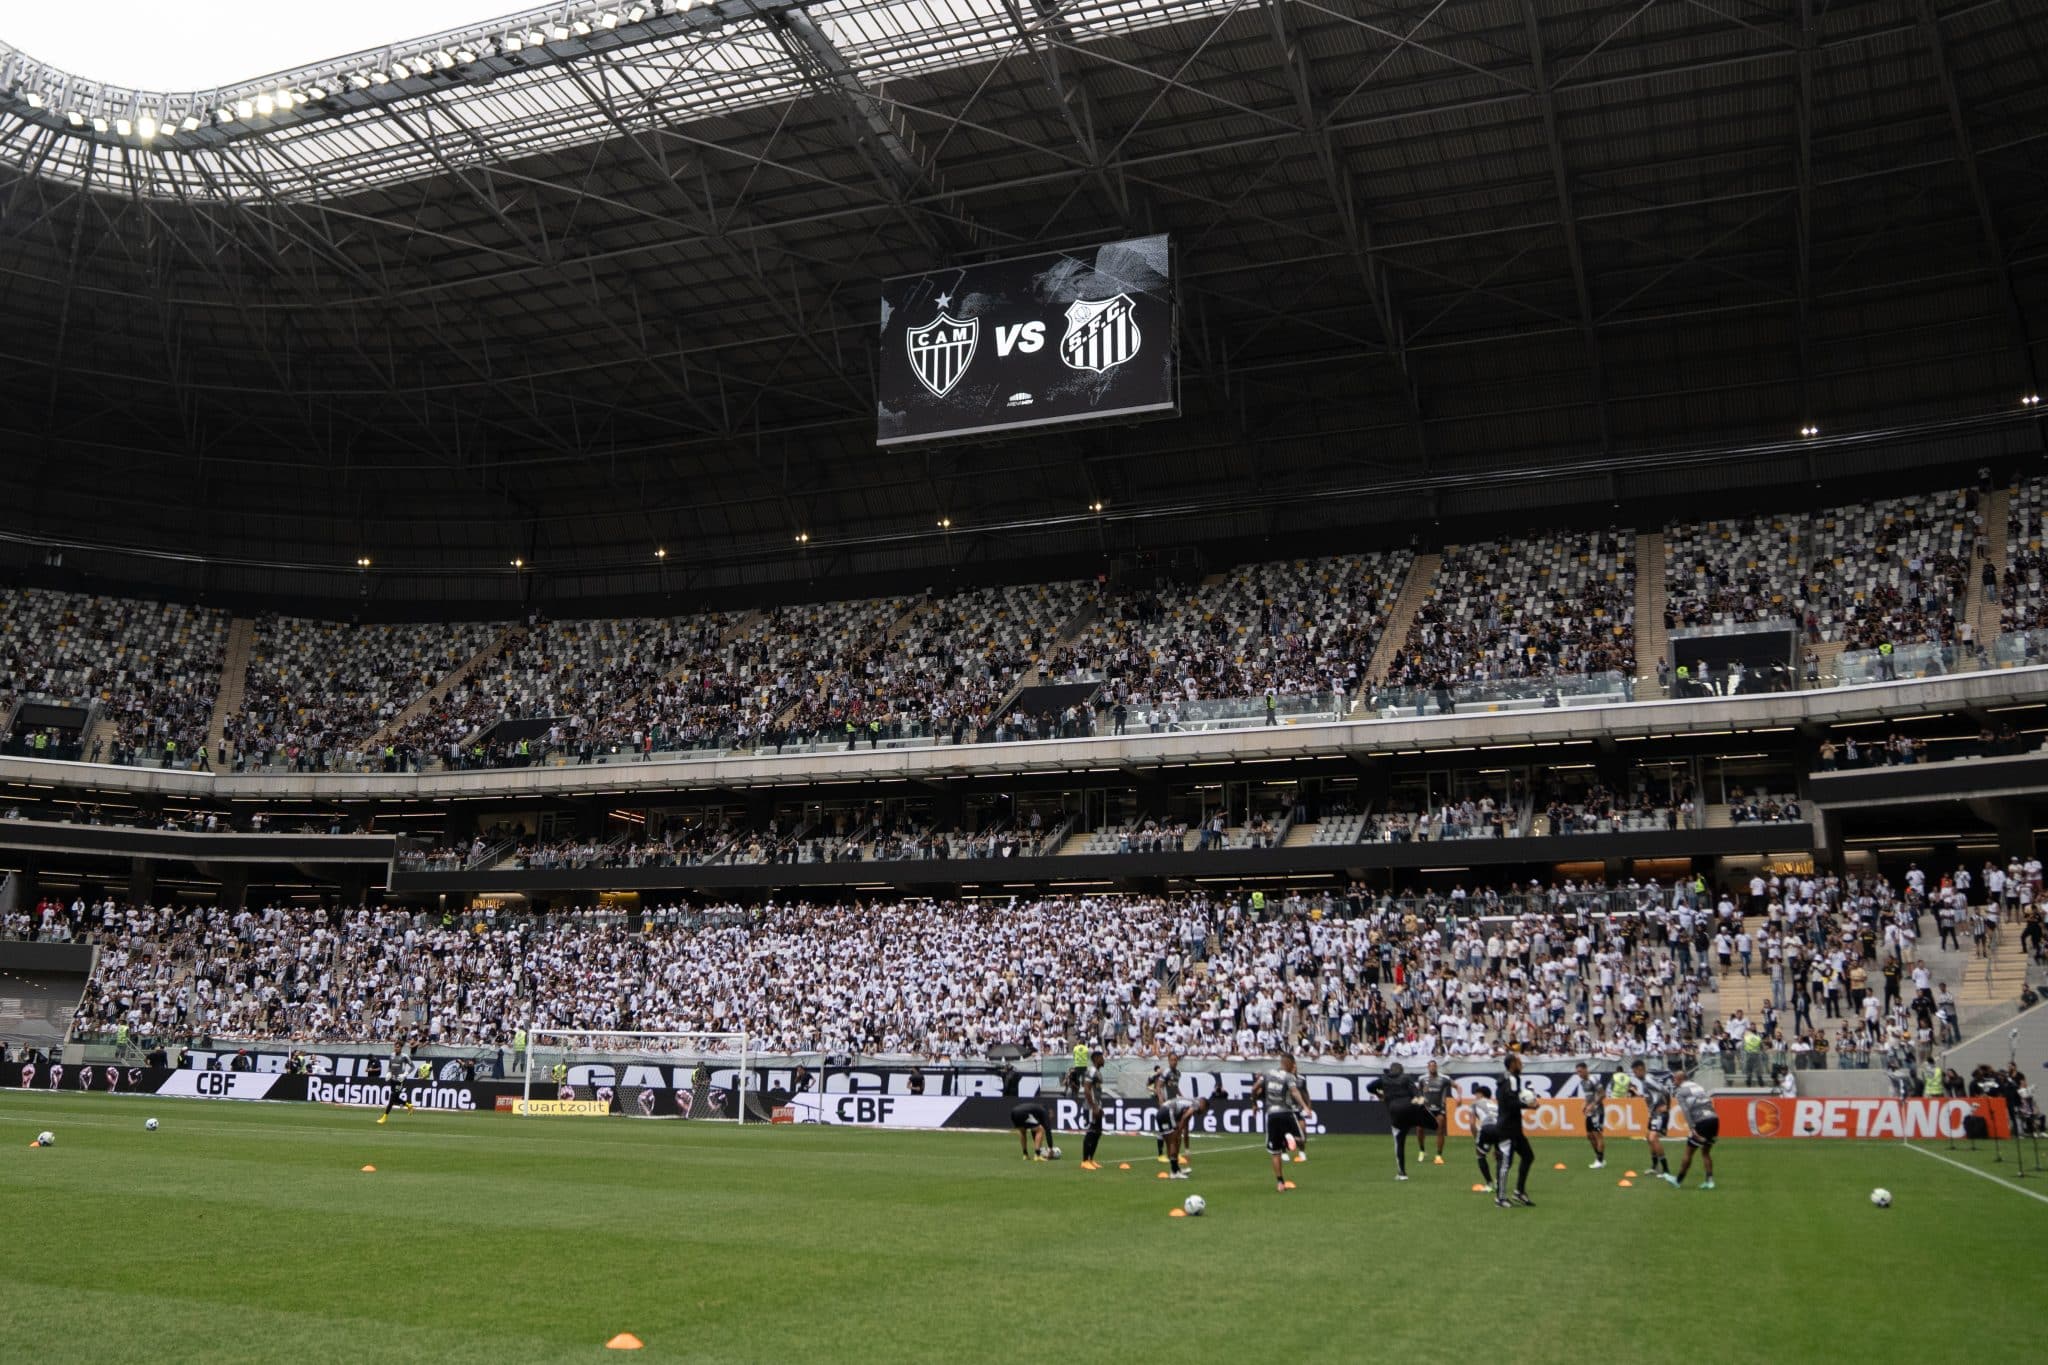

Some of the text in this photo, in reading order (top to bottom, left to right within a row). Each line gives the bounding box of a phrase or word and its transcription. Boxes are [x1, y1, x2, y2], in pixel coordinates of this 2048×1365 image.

[917, 327, 967, 347] CAM
[995, 320, 1047, 357] VS
[196, 1072, 237, 1095] CBF
[307, 1076, 392, 1106] Racismo
[411, 1081, 476, 1110] crime.
[837, 1097, 895, 1123] CBF
[1057, 1099, 1326, 1134] Rcism é crie.
[1521, 1104, 1574, 1131] GOL
[1604, 1104, 1641, 1131] OL
[1792, 1099, 1973, 1138] BETANO
